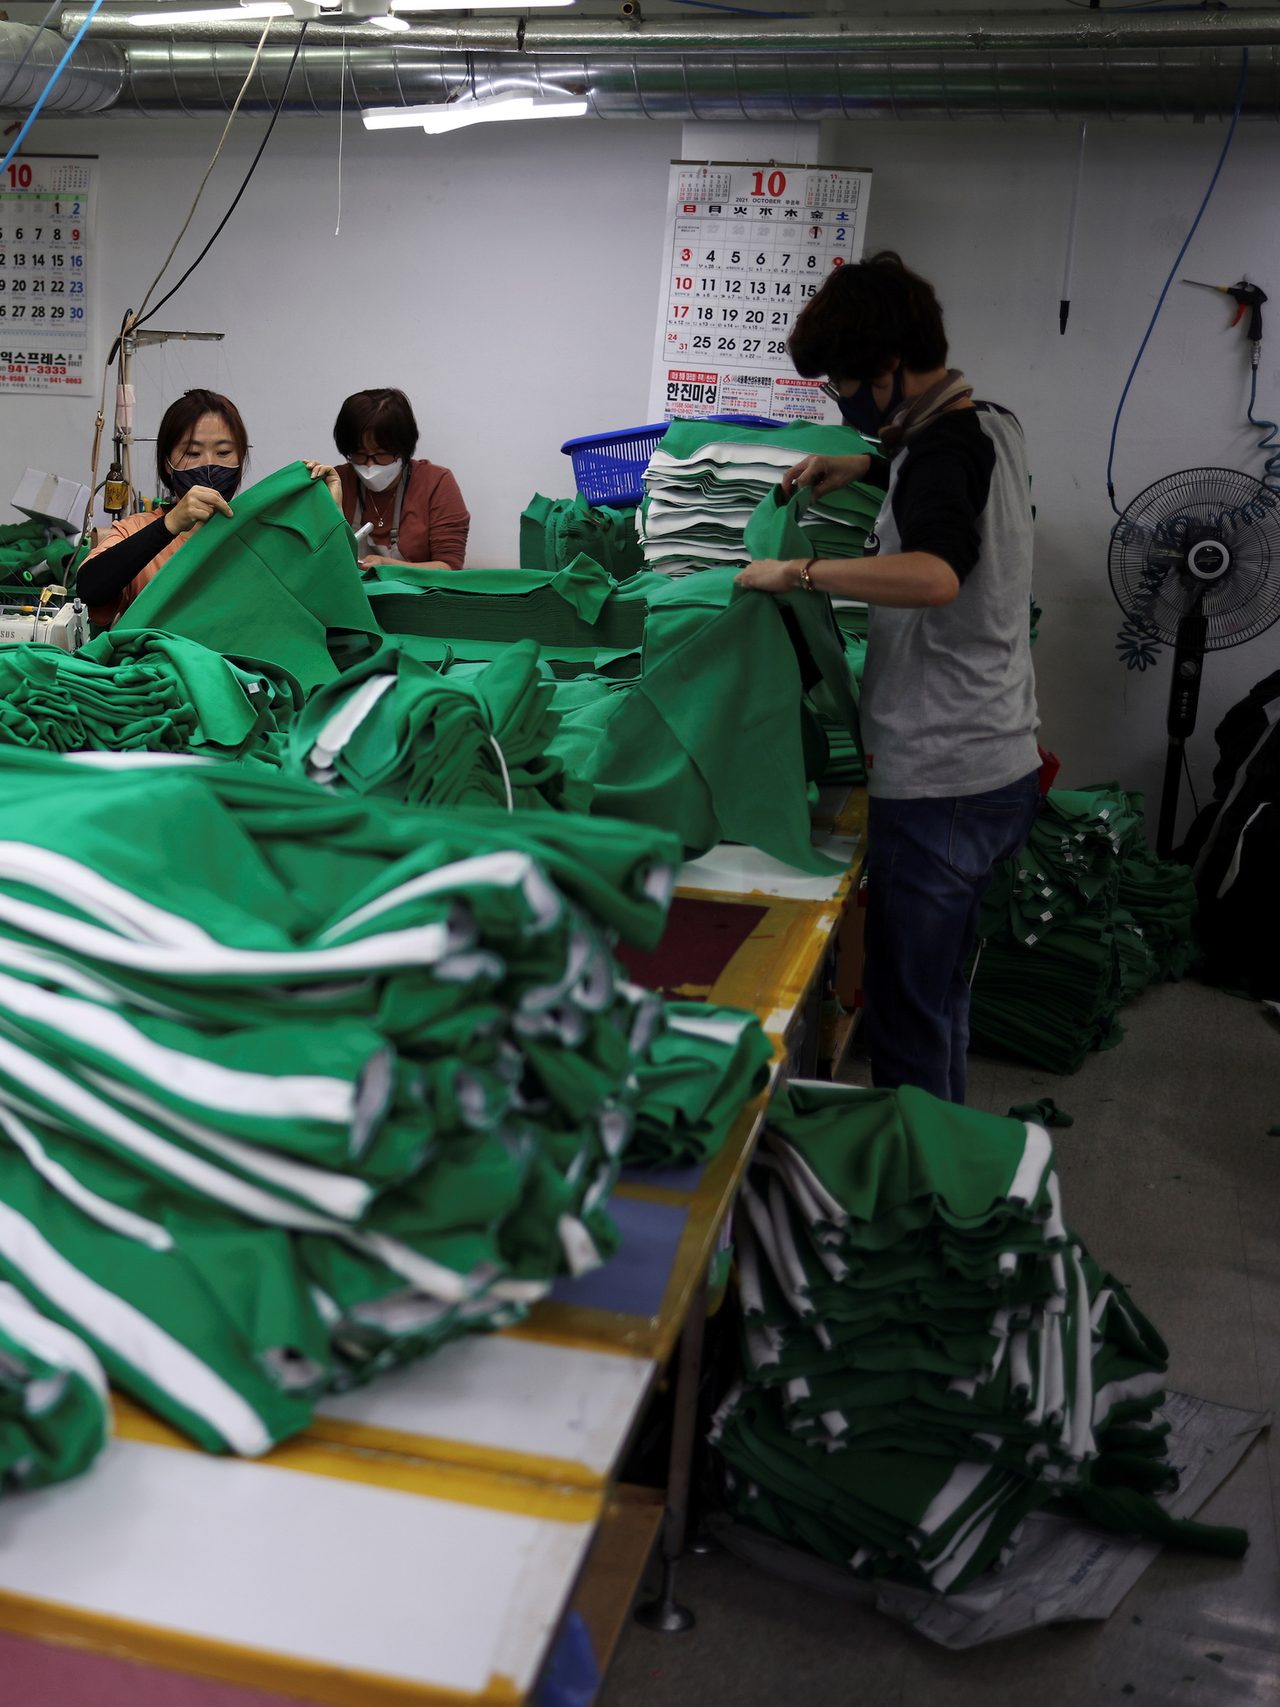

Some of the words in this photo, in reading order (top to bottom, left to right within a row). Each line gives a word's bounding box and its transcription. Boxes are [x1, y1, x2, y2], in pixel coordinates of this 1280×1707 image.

[7, 164, 32, 187] 10
[751, 171, 786, 197] 10
[54, 203, 60, 214] 1
[72, 203, 80, 214] 2
[684, 205, 697, 213] 日
[708, 205, 721, 214] 月
[733, 207, 747, 215] 火
[759, 207, 773, 216] 水
[810, 211, 823, 219] 金
[836, 212, 848, 220] 土
[16, 228, 23, 240] 6
[35, 229, 42, 240] 7
[54, 229, 61, 240] 8
[72, 229, 80, 241] 9
[812, 227, 818, 239] 1
[836, 228, 845, 241] 2
[13, 254, 26, 265] 13
[32, 254, 45, 266] 14
[51, 254, 64, 266] 15
[71, 255, 83, 267] 16
[681, 249, 690, 261] 3
[706, 251, 715, 262] 4
[731, 252, 740, 263] 5
[757, 253, 765, 265] 6
[782, 254, 791, 266] 7
[807, 256, 816, 268] 8
[12, 280, 26, 291] 20
[33, 281, 45, 292] 21
[51, 281, 64, 292] 22
[70, 281, 83, 293] 23
[675, 278, 692, 290] 10
[701, 279, 715, 290] 11
[725, 281, 741, 292] 12
[750, 282, 765, 294] 13
[775, 283, 791, 296] 14
[801, 285, 817, 297] 15
[12, 306, 25, 318] 27
[32, 306, 45, 318] 28
[51, 307, 64, 319] 29
[70, 307, 83, 319] 30
[674, 306, 689, 318] 17
[698, 308, 713, 320] 18
[722, 309, 738, 321] 19
[745, 311, 764, 323] 20
[772, 313, 788, 325] 21
[693, 336, 711, 348] 25
[718, 338, 735, 350] 26
[743, 340, 760, 352] 27
[767, 342, 785, 354] 28
[0, 352, 66, 365] 익스프레스
[8, 365, 66, 375] 941-3333
[667, 383, 717, 404] 한진미싱
